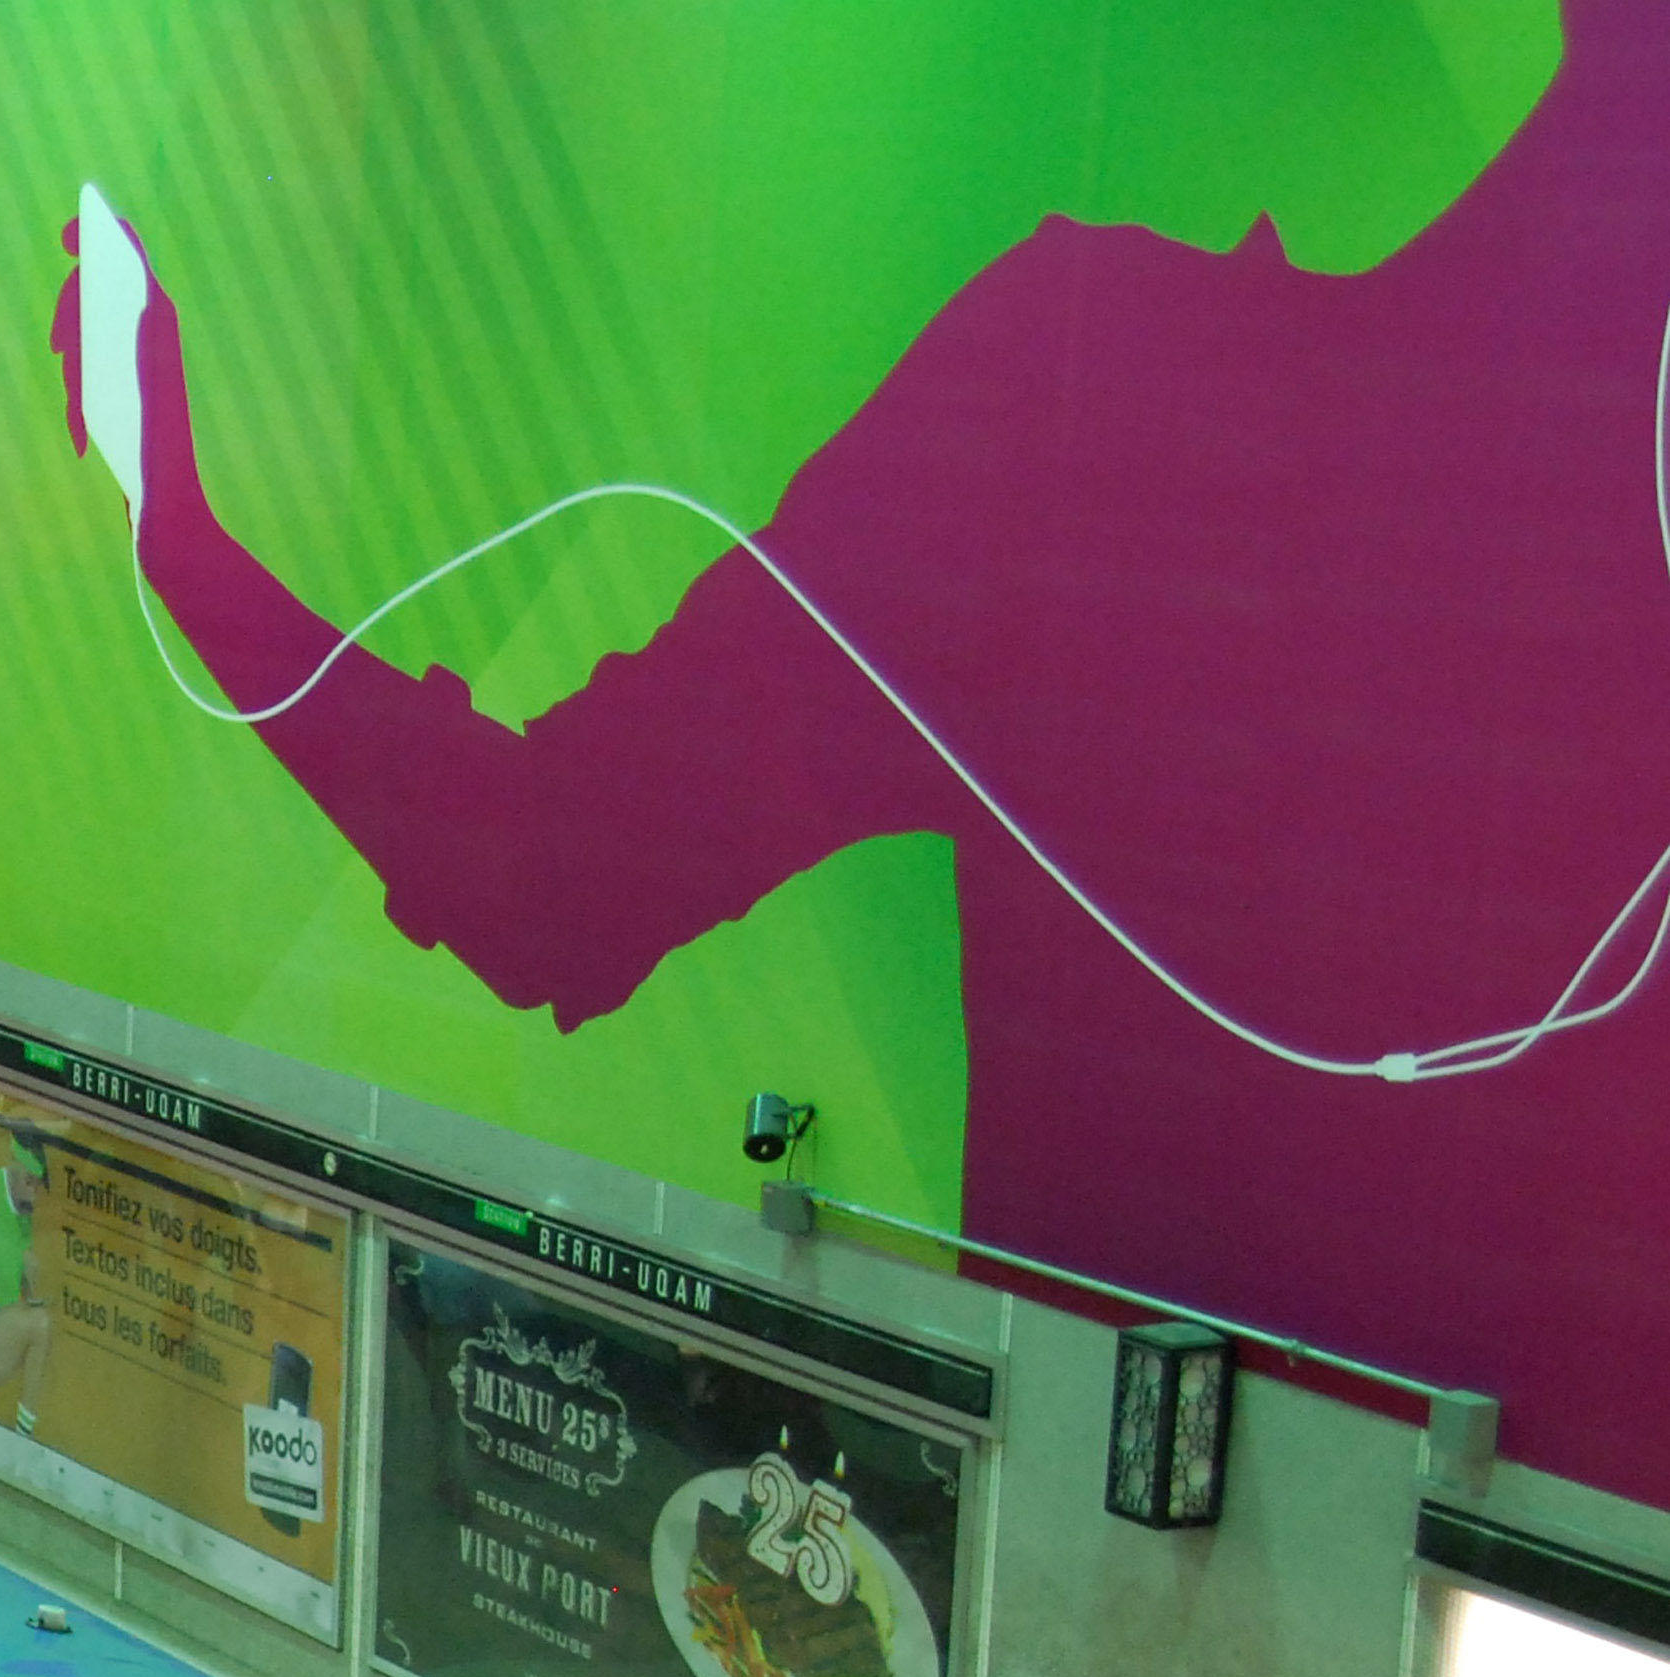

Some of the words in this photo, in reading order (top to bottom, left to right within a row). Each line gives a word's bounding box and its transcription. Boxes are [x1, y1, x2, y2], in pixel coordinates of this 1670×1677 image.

[72, 1062, 201, 1129] BERRI-UQAM
[64, 1164, 143, 1227] Tonifiez
[149, 1207, 184, 1244] vos
[191, 1217, 262, 1275] doigts.
[61, 1225, 129, 1282] Textos
[135, 1253, 196, 1310] inclus
[201, 1286, 255, 1336] dans
[538, 1226, 711, 1312] BERRI-UQAM
[62, 1285, 108, 1332] tous
[113, 1304, 143, 1346] les
[149, 1320, 229, 1385] forfaits.
[473, 1366, 555, 1435] MENU
[248, 1425, 317, 1467] koodo
[510, 1442, 581, 1490] SERVICES
[475, 1489, 597, 1553] RESTAURANT
[747, 1453, 852, 1607] 25
[460, 1524, 531, 1592] VIEUX
[541, 1562, 612, 1627] PORT
[472, 1591, 593, 1660] STEAKHOUSE
